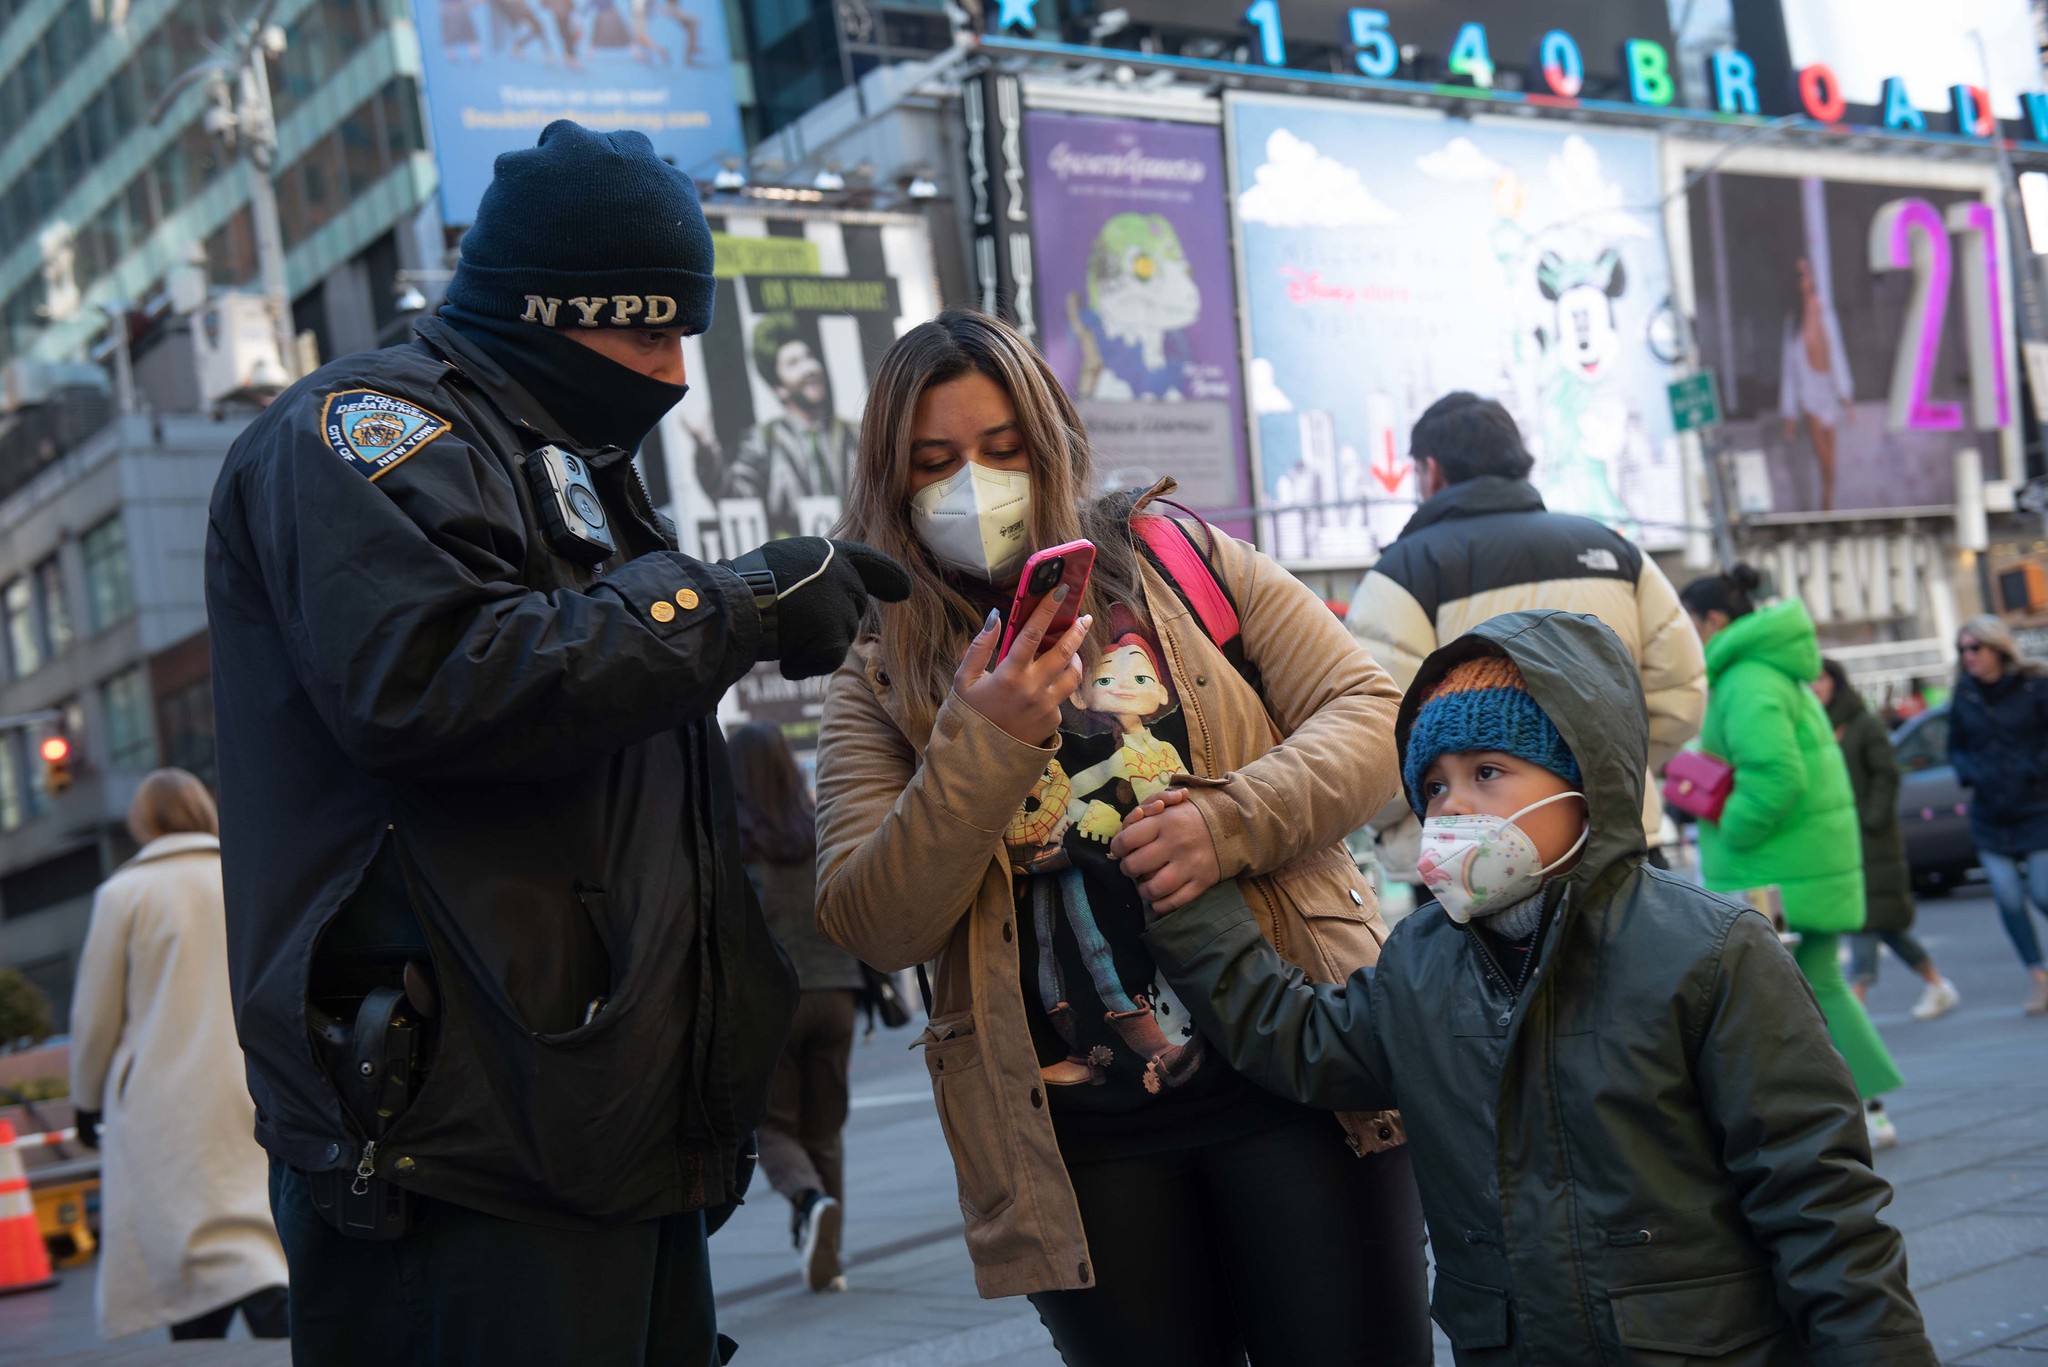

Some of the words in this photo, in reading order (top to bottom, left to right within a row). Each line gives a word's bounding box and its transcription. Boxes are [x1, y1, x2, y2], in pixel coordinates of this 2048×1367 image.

[520, 294, 677, 327] NYPD
[1869, 197, 2010, 432] 21
[335, 402, 437, 425] DEPARTMENT
[362, 395, 421, 414] POLICE
[328, 424, 346, 447] CITY
[340, 447, 356, 462] OF
[376, 445, 407, 467] NEW
[404, 425, 437, 446] YORK
